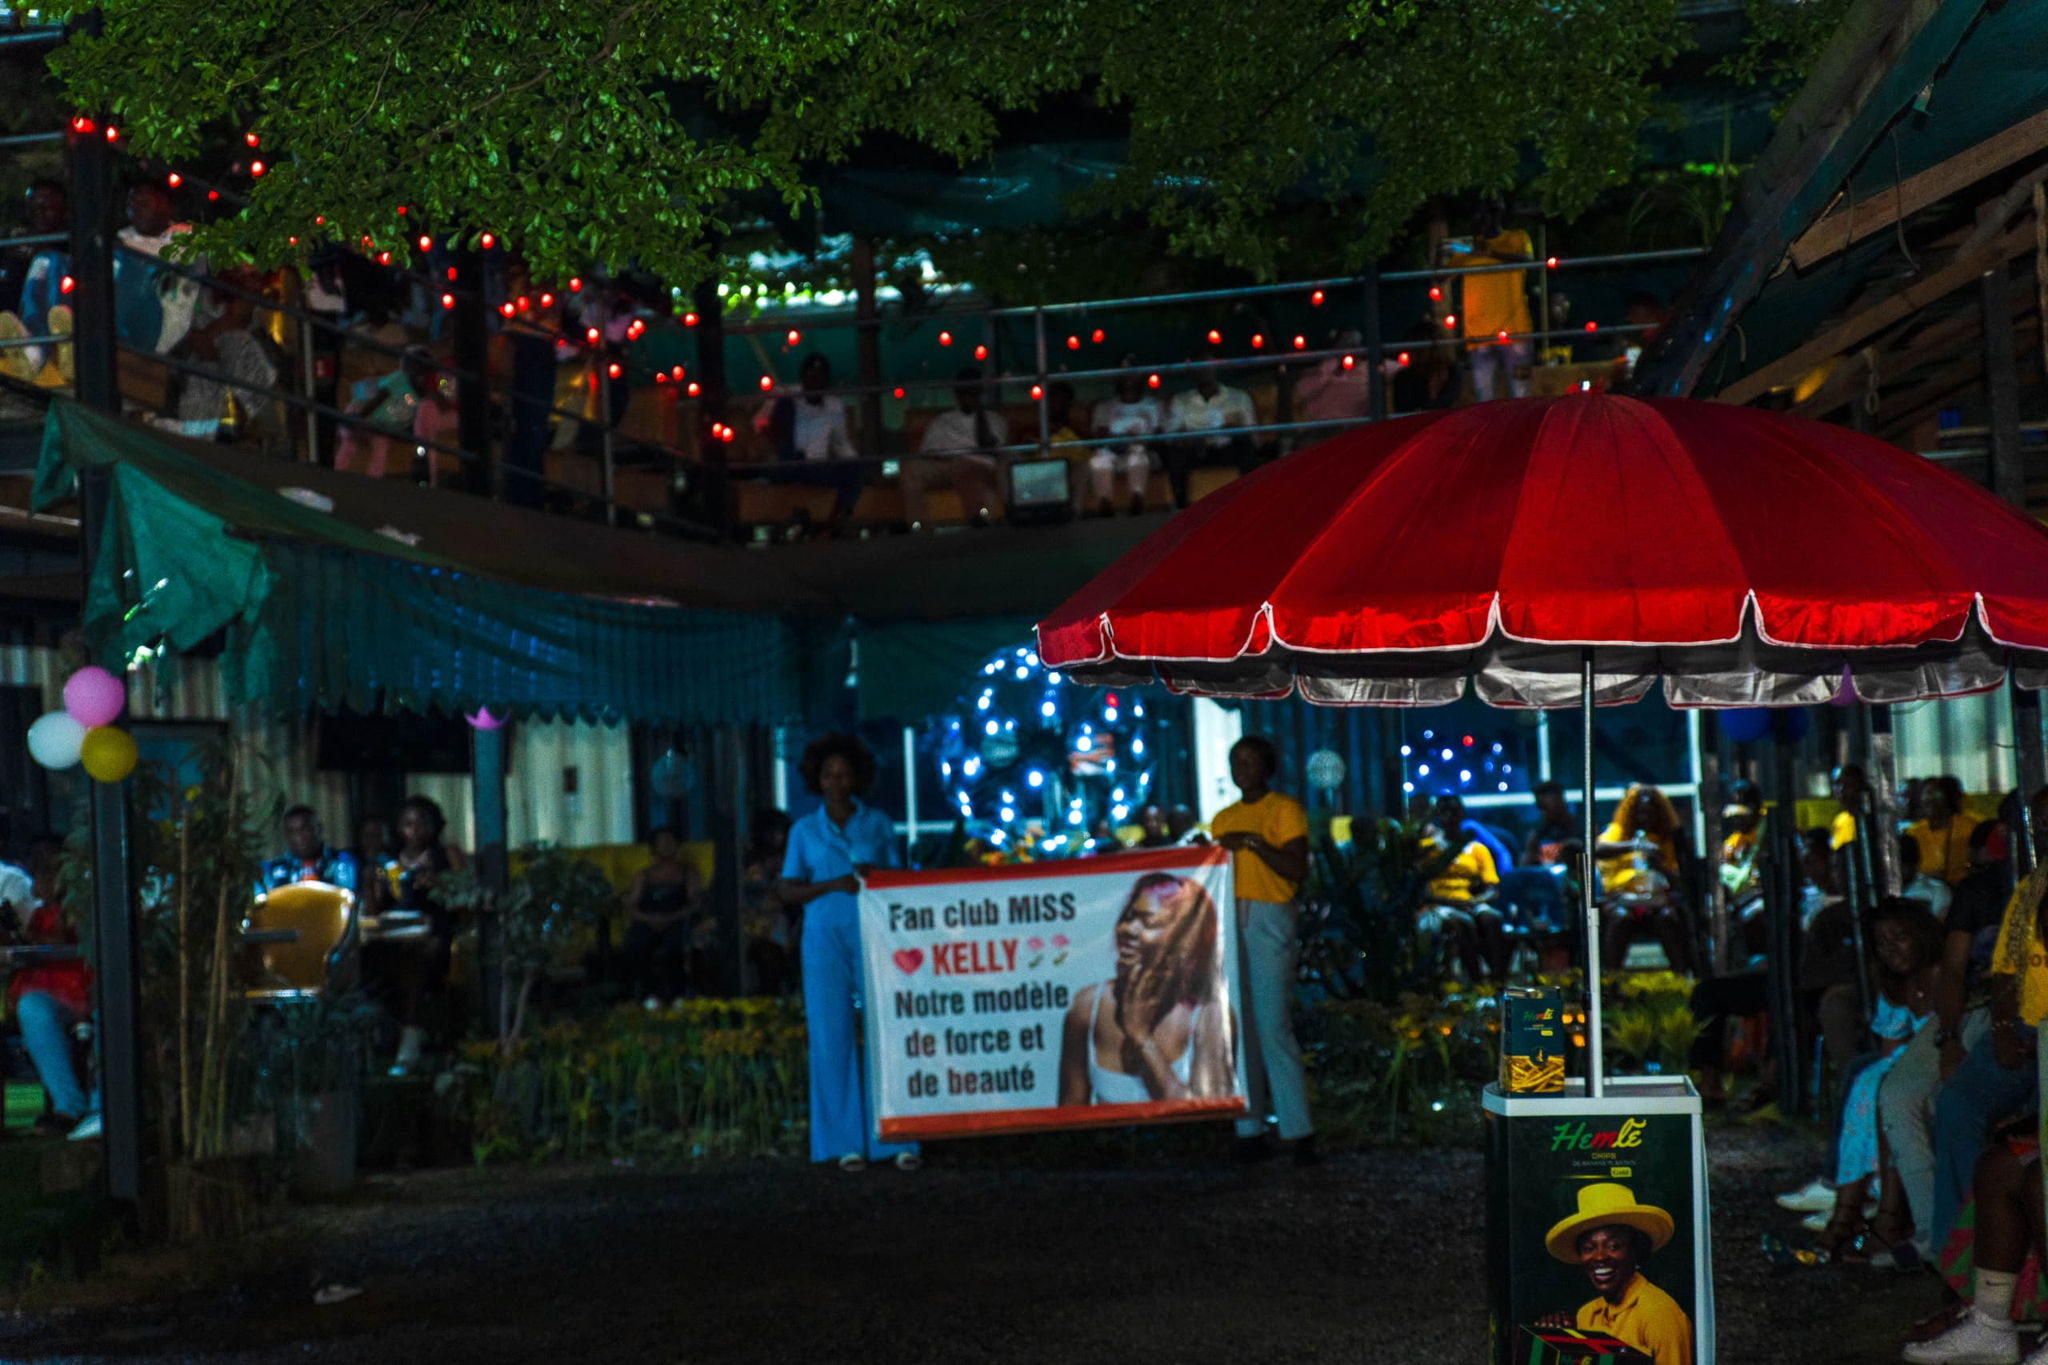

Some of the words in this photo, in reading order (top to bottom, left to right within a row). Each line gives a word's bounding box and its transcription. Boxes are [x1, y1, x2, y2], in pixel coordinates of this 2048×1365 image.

[888, 904, 935, 931] Fan
[943, 899, 999, 928] club
[1008, 893, 1075, 924] MISS
[932, 939, 1018, 976] KELLY
[895, 991, 964, 1019] Notre
[974, 981, 1068, 1014] modèle
[906, 1030, 935, 1058] de
[945, 1028, 1010, 1056] force
[1020, 1024, 1044, 1050] et
[908, 1070, 937, 1098] de
[948, 1061, 1035, 1096] beauté
